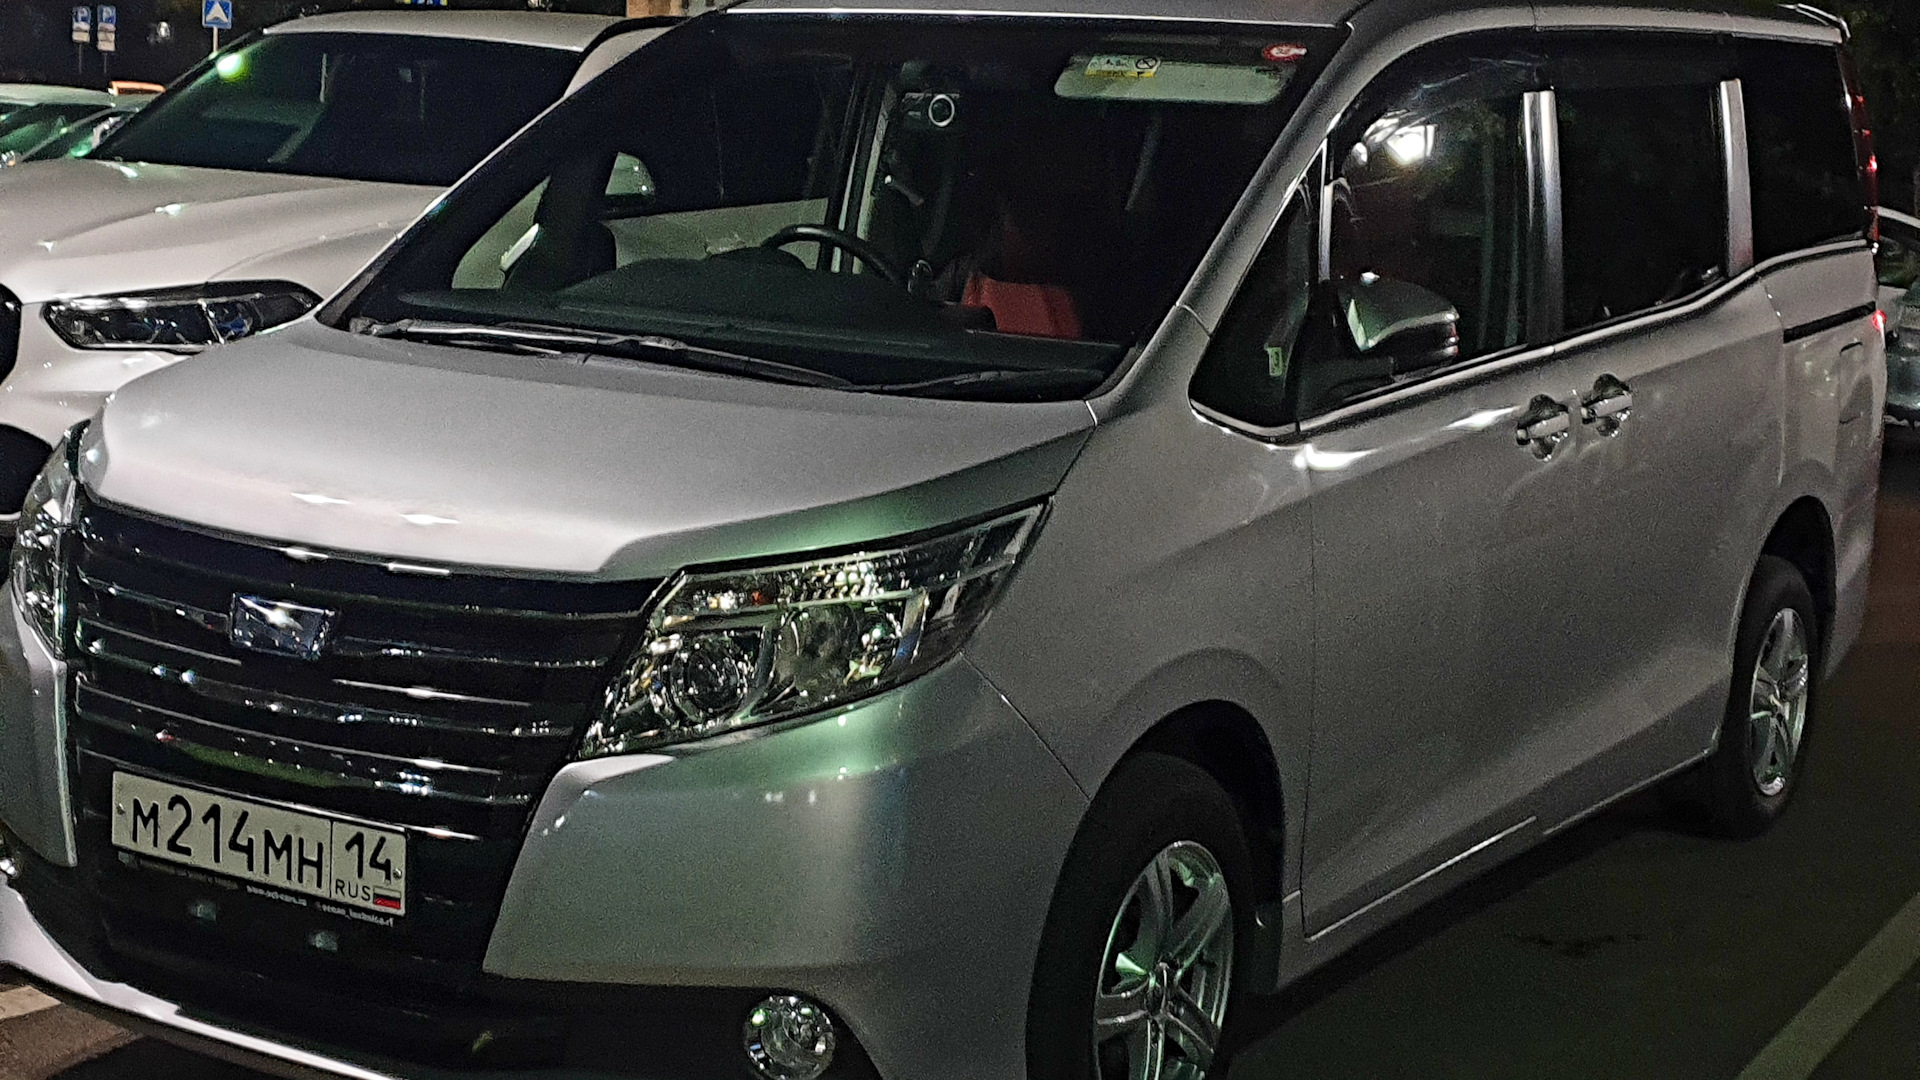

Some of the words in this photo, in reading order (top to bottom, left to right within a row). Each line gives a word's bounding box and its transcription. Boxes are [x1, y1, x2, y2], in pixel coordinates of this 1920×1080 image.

[77, 7, 88, 22] P
[345, 832, 391, 882] 14
[335, 879, 371, 901] RUS
